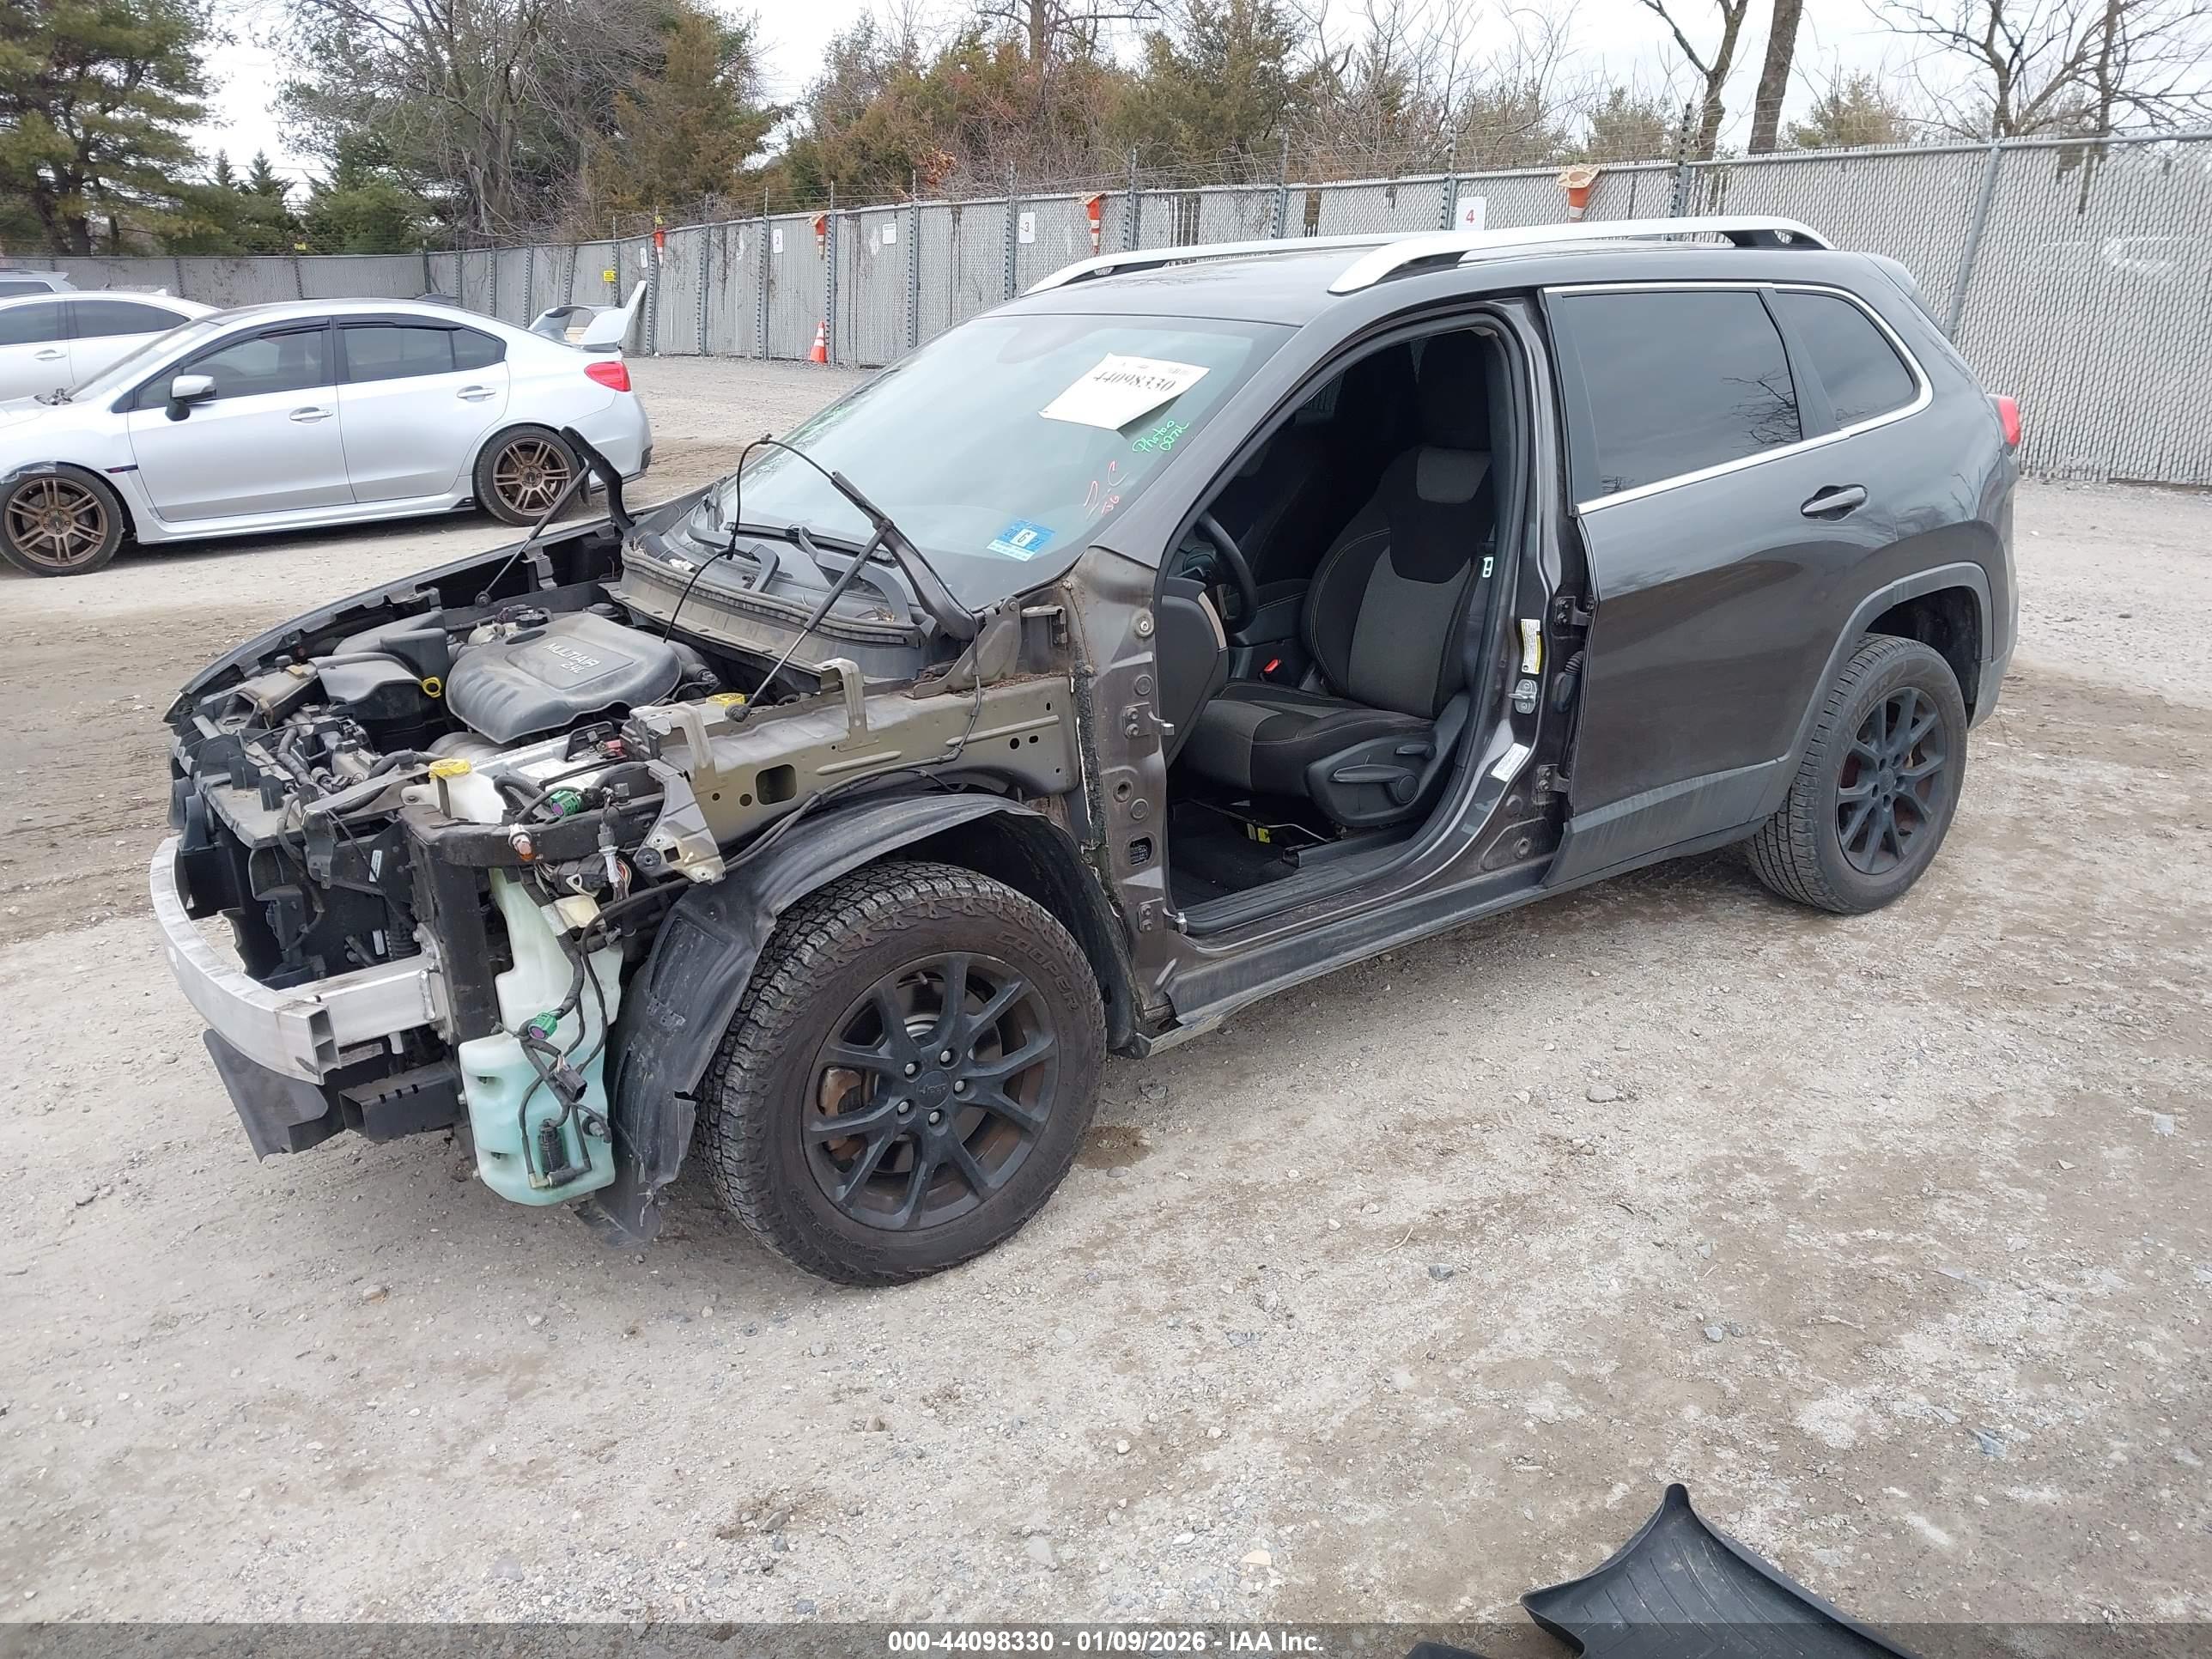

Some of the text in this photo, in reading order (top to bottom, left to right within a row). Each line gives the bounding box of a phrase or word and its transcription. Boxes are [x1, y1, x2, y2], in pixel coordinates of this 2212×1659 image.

[1465, 209, 1475, 223] 4
[1024, 221, 1030, 232] 3
[1092, 371, 1177, 392] 44098330
[1018, 532, 1031, 544] 6
[543, 642, 601, 668] MULTIAIR
[996, 930, 1082, 1011] COOPER
